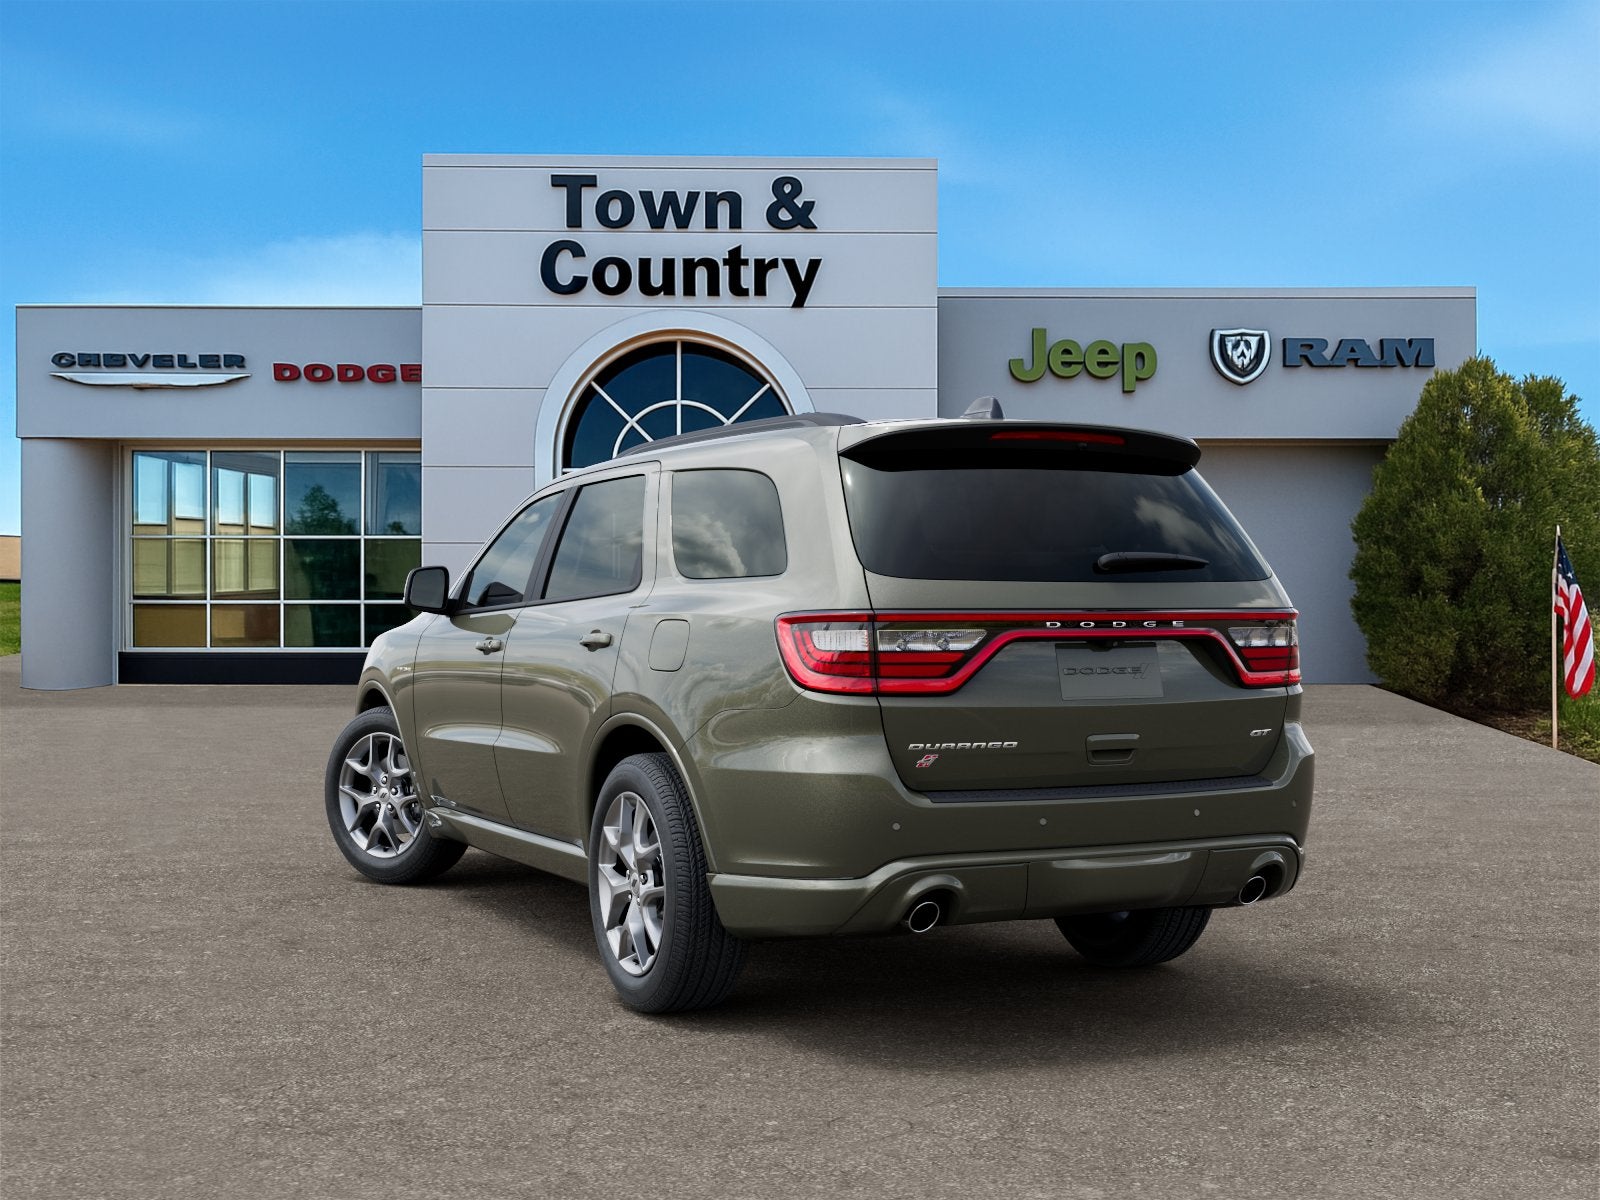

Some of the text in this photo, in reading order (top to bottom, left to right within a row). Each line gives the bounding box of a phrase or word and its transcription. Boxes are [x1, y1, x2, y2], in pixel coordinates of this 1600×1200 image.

[550, 174, 818, 230] Town &
[539, 239, 823, 308] Country
[1009, 328, 1158, 393] Jeep
[1283, 338, 1435, 368] RAM
[273, 363, 422, 384] DODGE
[1045, 620, 1185, 629] DODGE
[1063, 666, 1143, 676] DODGE
[907, 741, 1019, 751] DURANGO
